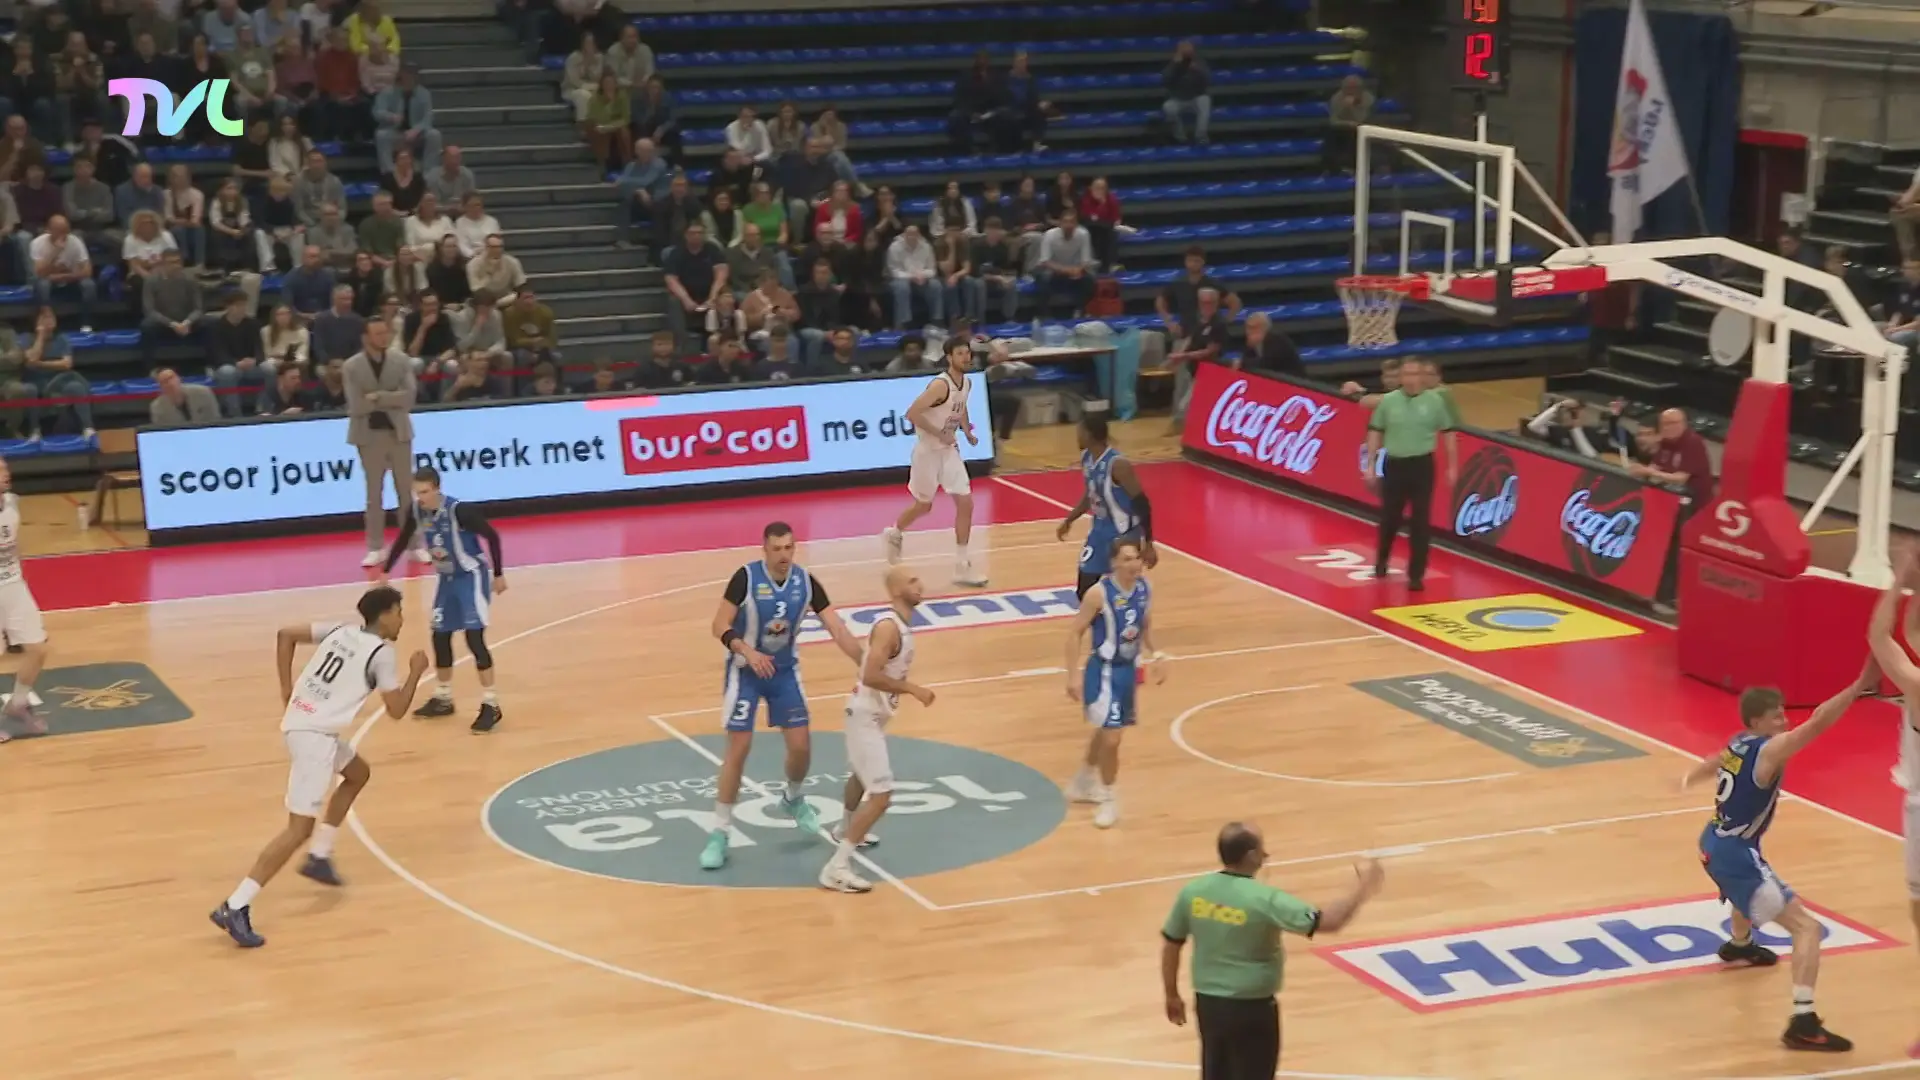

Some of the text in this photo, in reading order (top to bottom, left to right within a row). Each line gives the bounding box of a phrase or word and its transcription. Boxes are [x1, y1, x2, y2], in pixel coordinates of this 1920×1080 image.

[160, 466, 258, 495] scoor
[271, 455, 354, 495] jouw
[415, 438, 531, 472] ntwerk
[542, 435, 605, 464] met
[631, 420, 799, 461] burocad
[822, 417, 867, 442] me
[774, 601, 787, 618] 3
[315, 651, 344, 684] 10
[733, 700, 751, 721] 3
